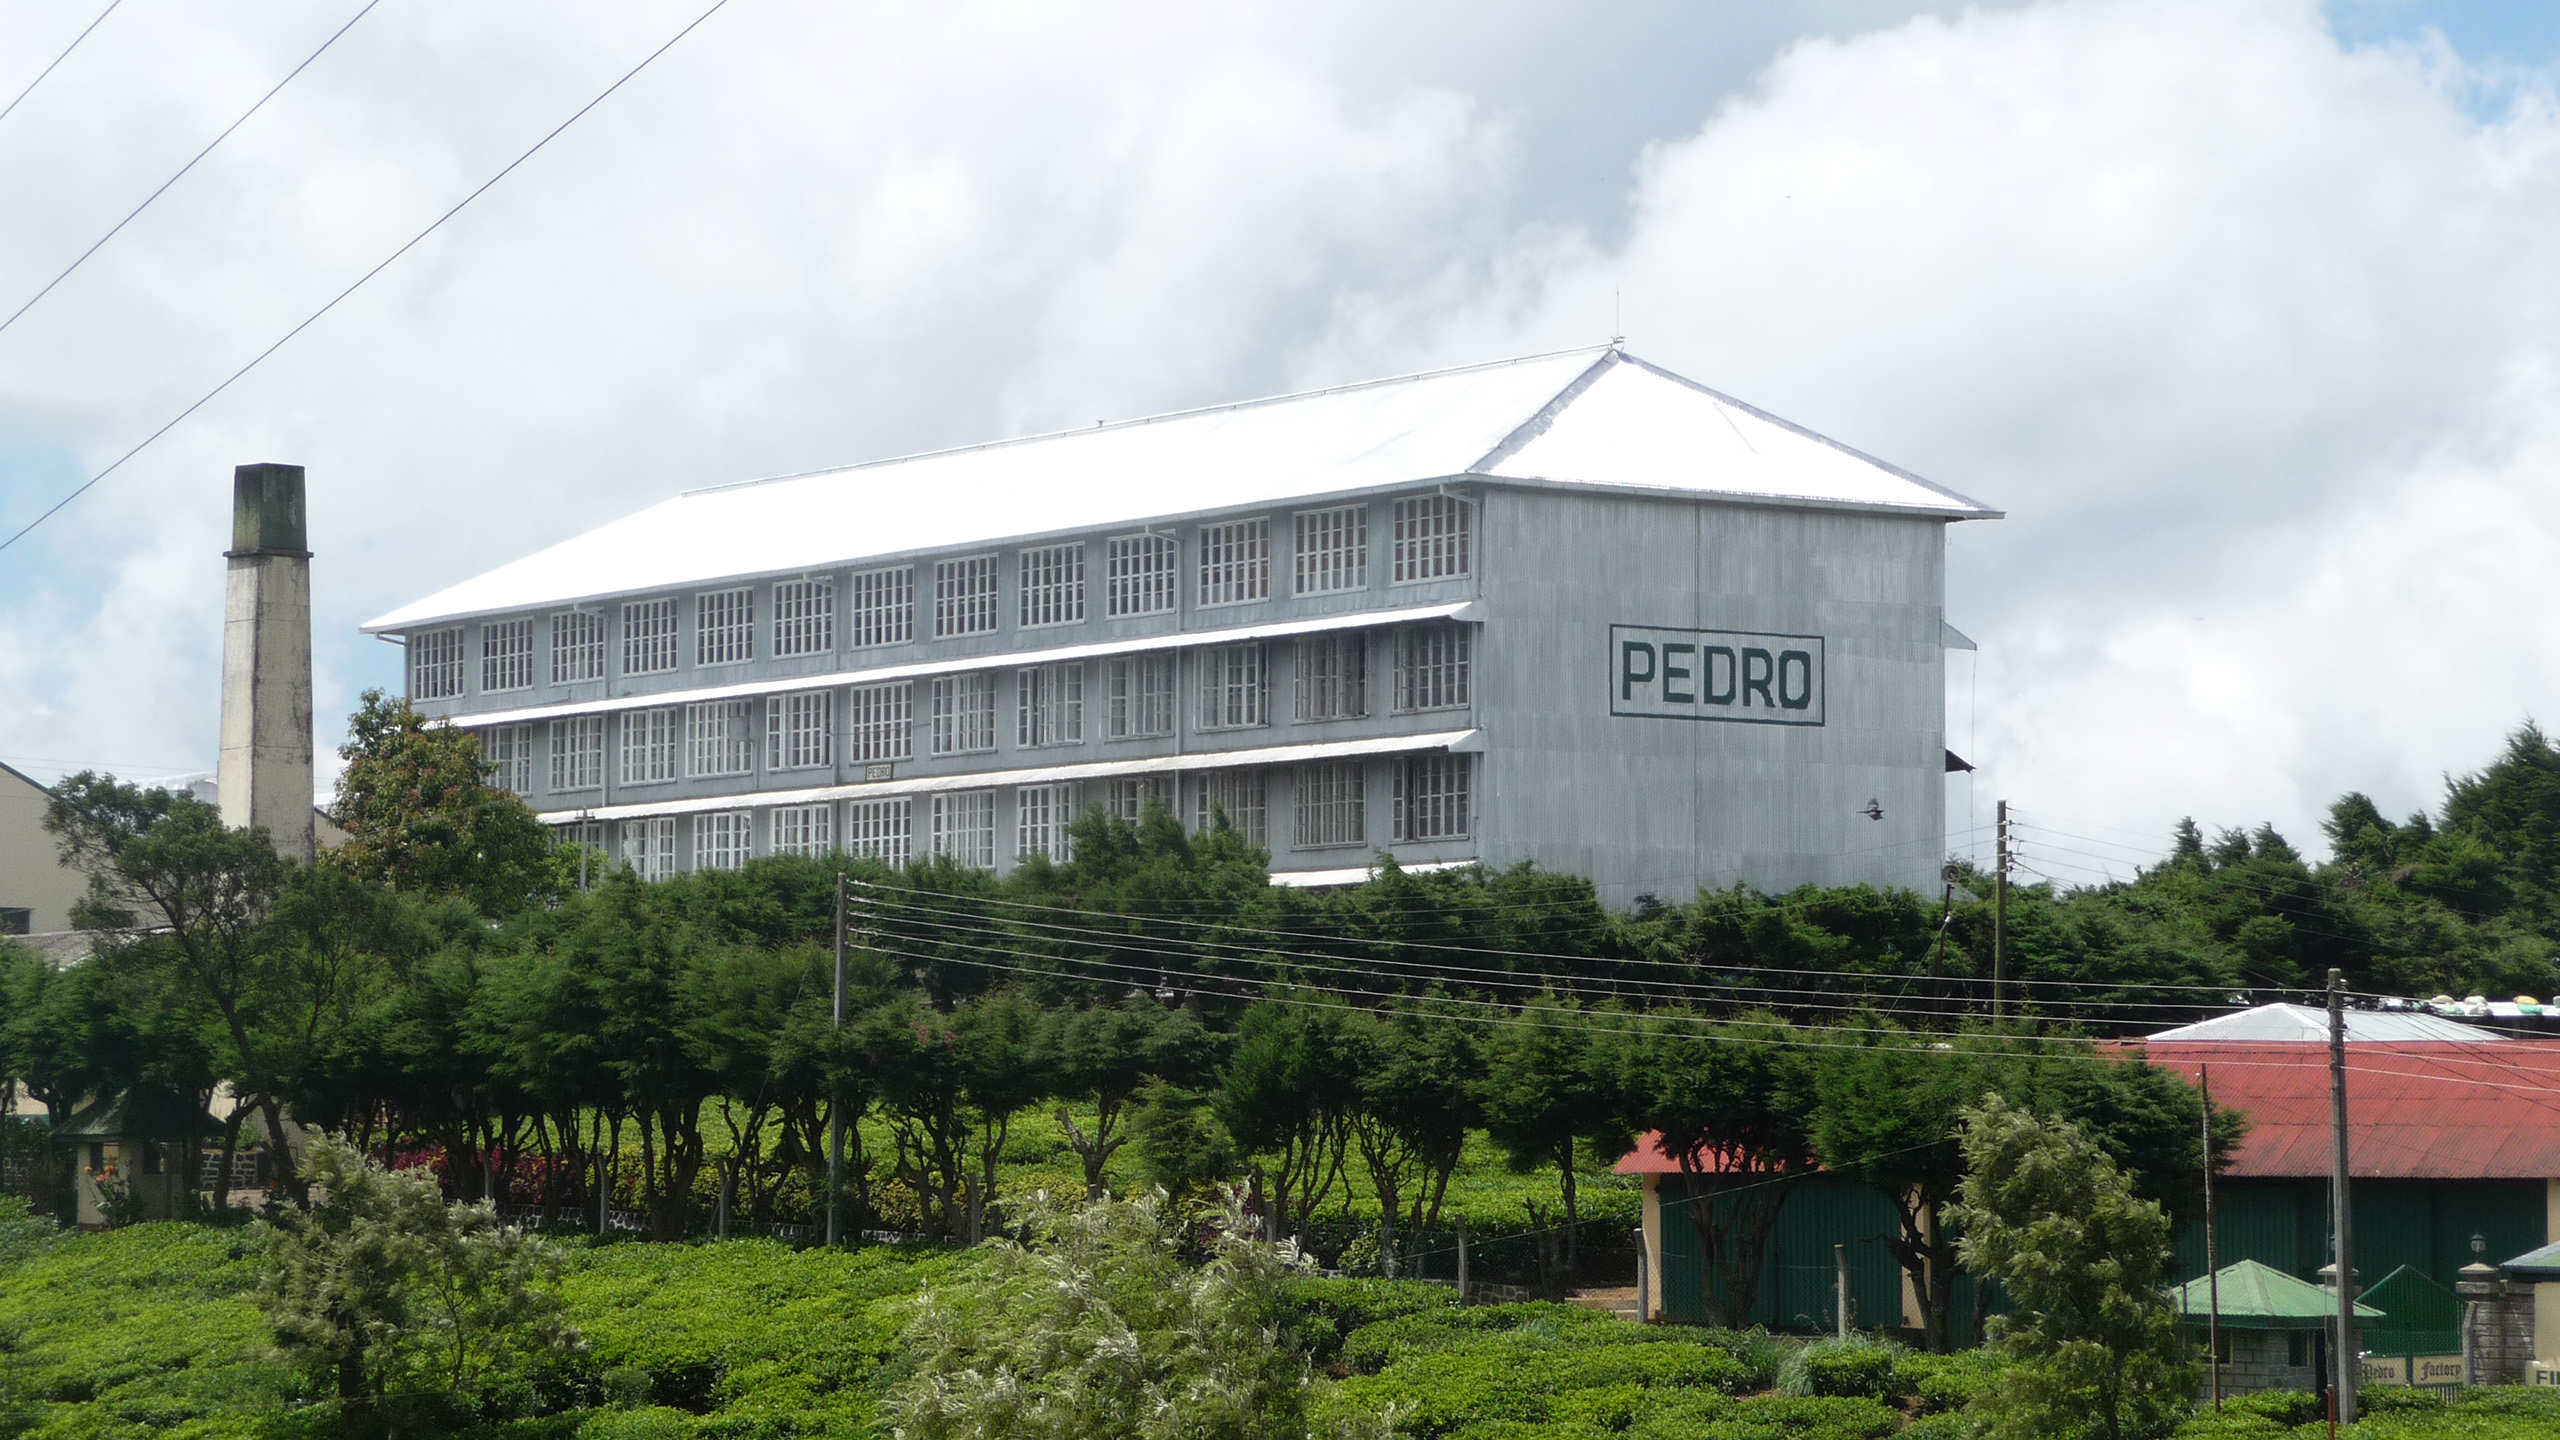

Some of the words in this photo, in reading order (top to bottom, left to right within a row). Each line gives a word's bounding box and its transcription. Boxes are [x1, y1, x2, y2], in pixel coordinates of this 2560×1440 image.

[1622, 641, 1811, 709] PEDRO
[867, 766, 890, 779] PEDRO
[2361, 1363, 2395, 1382] Pedro
[2421, 1361, 2462, 1381] Factory
[2536, 1370, 2560, 1385] FI
